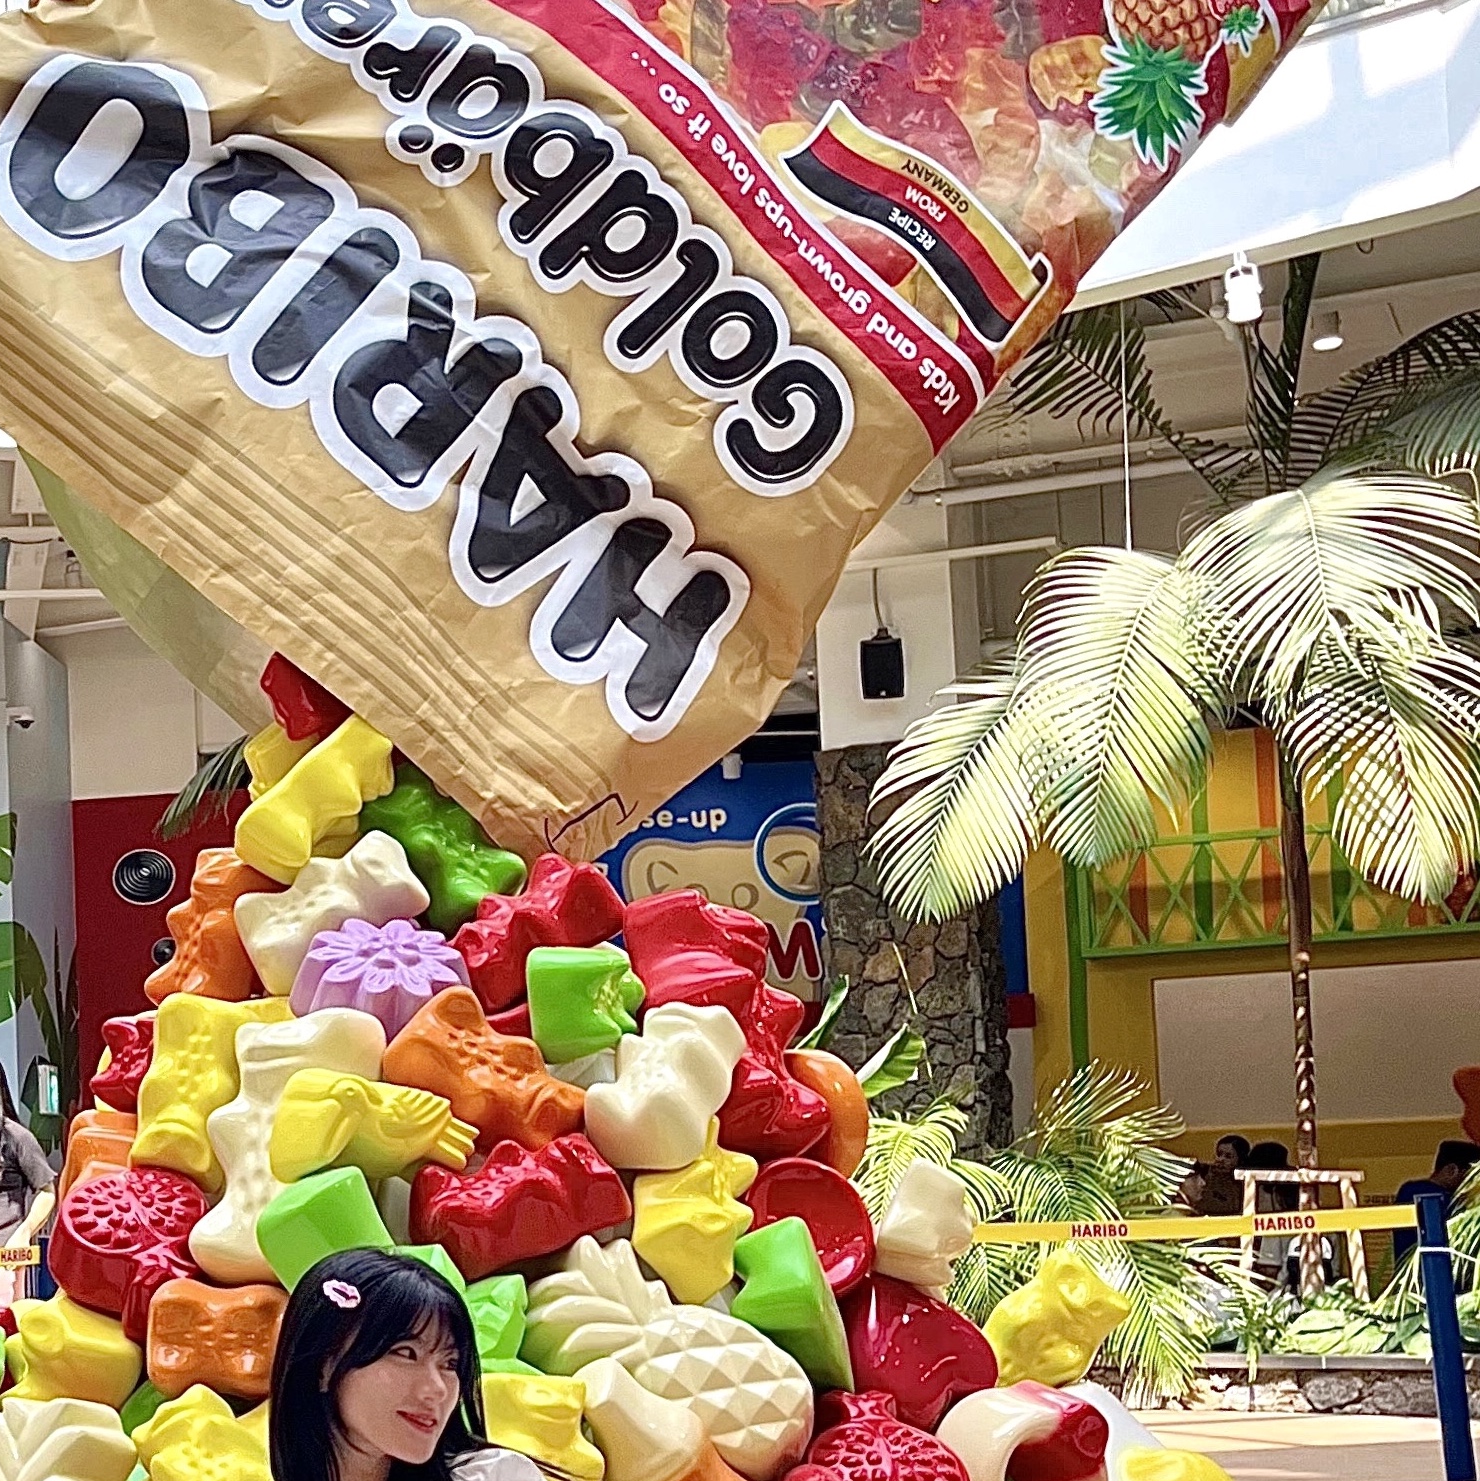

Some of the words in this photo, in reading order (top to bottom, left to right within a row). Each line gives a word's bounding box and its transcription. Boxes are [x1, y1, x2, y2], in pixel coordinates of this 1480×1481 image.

[658, 82, 691, 115] so
[686, 112, 713, 142] it
[710, 133, 756, 196] love
[900, 158, 969, 214] GERMANY
[904, 184, 947, 223] FROM
[260, 0, 844, 485] Goldbäre
[754, 186, 872, 315] grown-ups
[887, 206, 937, 251] RECIPE
[865, 311, 918, 361] and
[7, 60, 732, 724] HARIBO
[1071, 1223, 1129, 1238] HARIBO
[1254, 1215, 1316, 1232] HARIBO
[0, 1248, 34, 1264] HARIBO
